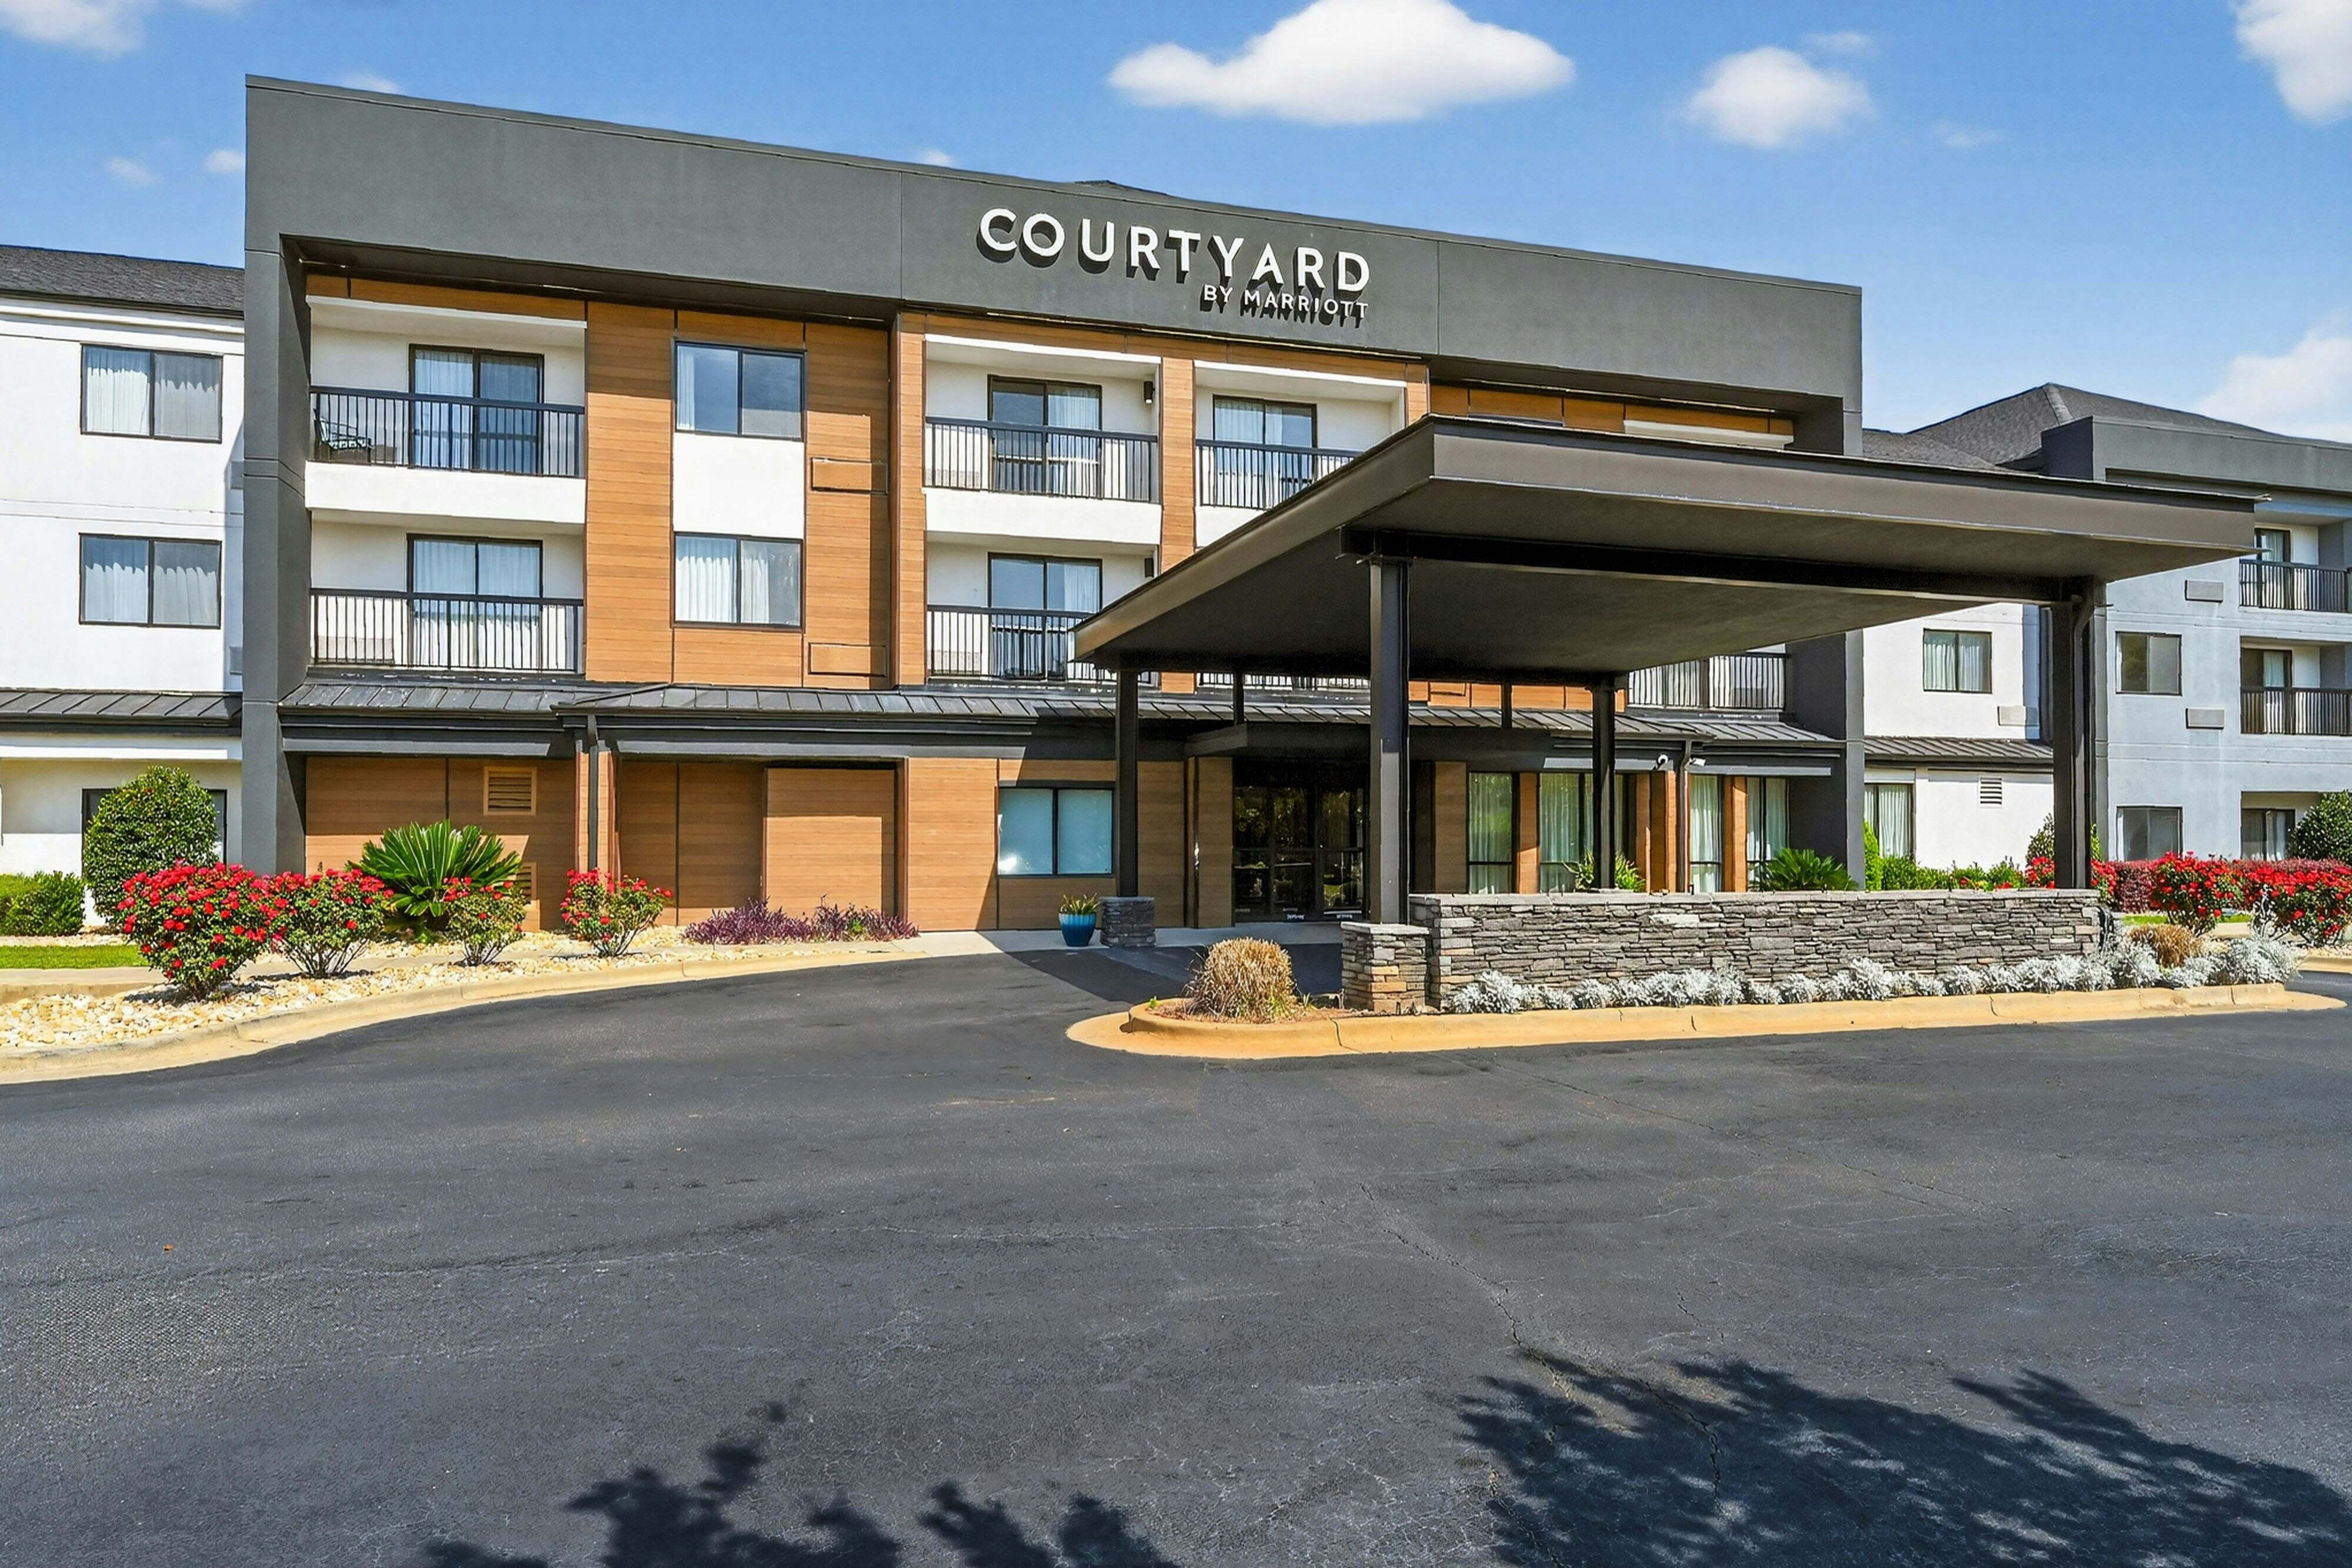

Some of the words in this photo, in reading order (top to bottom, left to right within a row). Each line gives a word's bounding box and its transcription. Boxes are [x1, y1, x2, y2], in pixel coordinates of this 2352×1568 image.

[979, 208, 1371, 292] COURTYARD
[1204, 285, 1234, 303] BY
[1244, 290, 1369, 319] MARRIOTT
